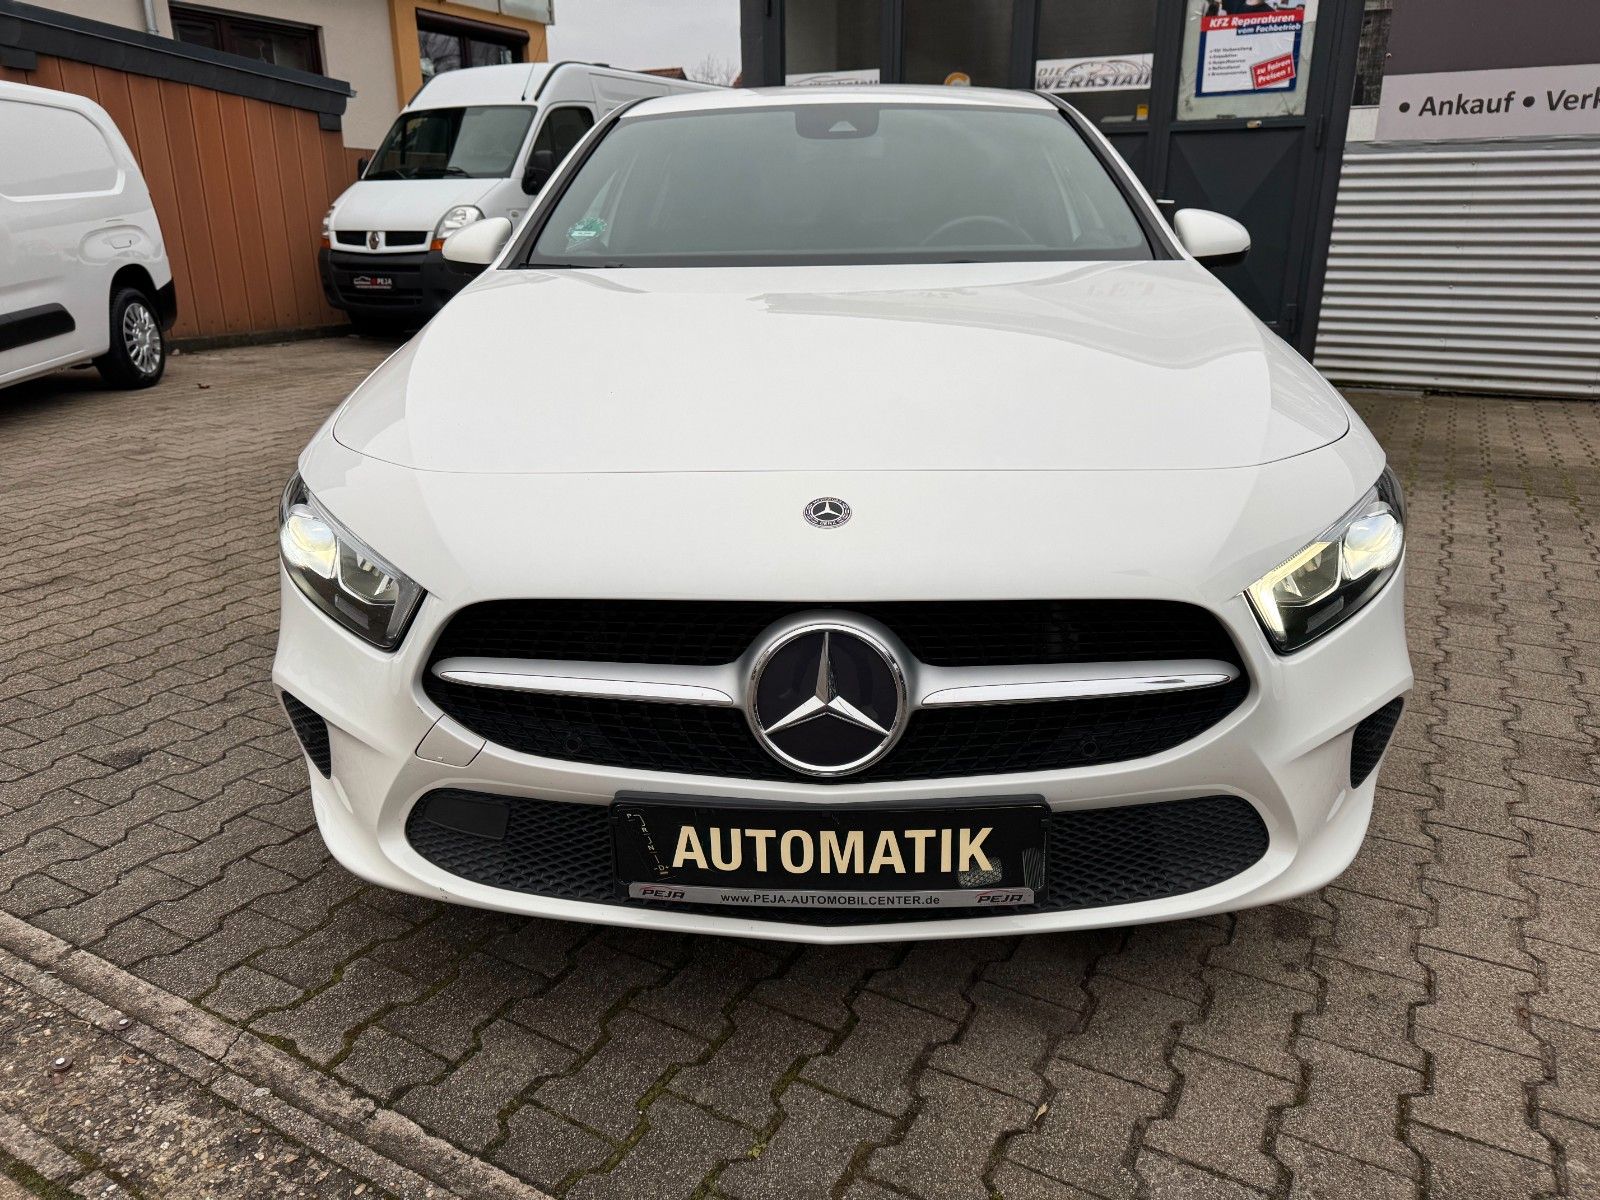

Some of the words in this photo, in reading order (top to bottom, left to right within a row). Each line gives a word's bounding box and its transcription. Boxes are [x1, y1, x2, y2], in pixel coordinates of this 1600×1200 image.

[1209, 17, 1230, 28] KFZ
[1231, 14, 1296, 27] Reparaturen
[1255, 23, 1302, 33] Fachbetrieb
[1267, 60, 1291, 72] fairen
[1258, 70, 1287, 83] Preisen
[1418, 91, 1516, 116] Ankauf
[672, 825, 993, 874] AUTOMATIK
[642, 889, 686, 900] PEJA
[720, 894, 940, 906] www.PEJA-AUTOMOBILCENTER.de
[976, 893, 1024, 904] PEJA
